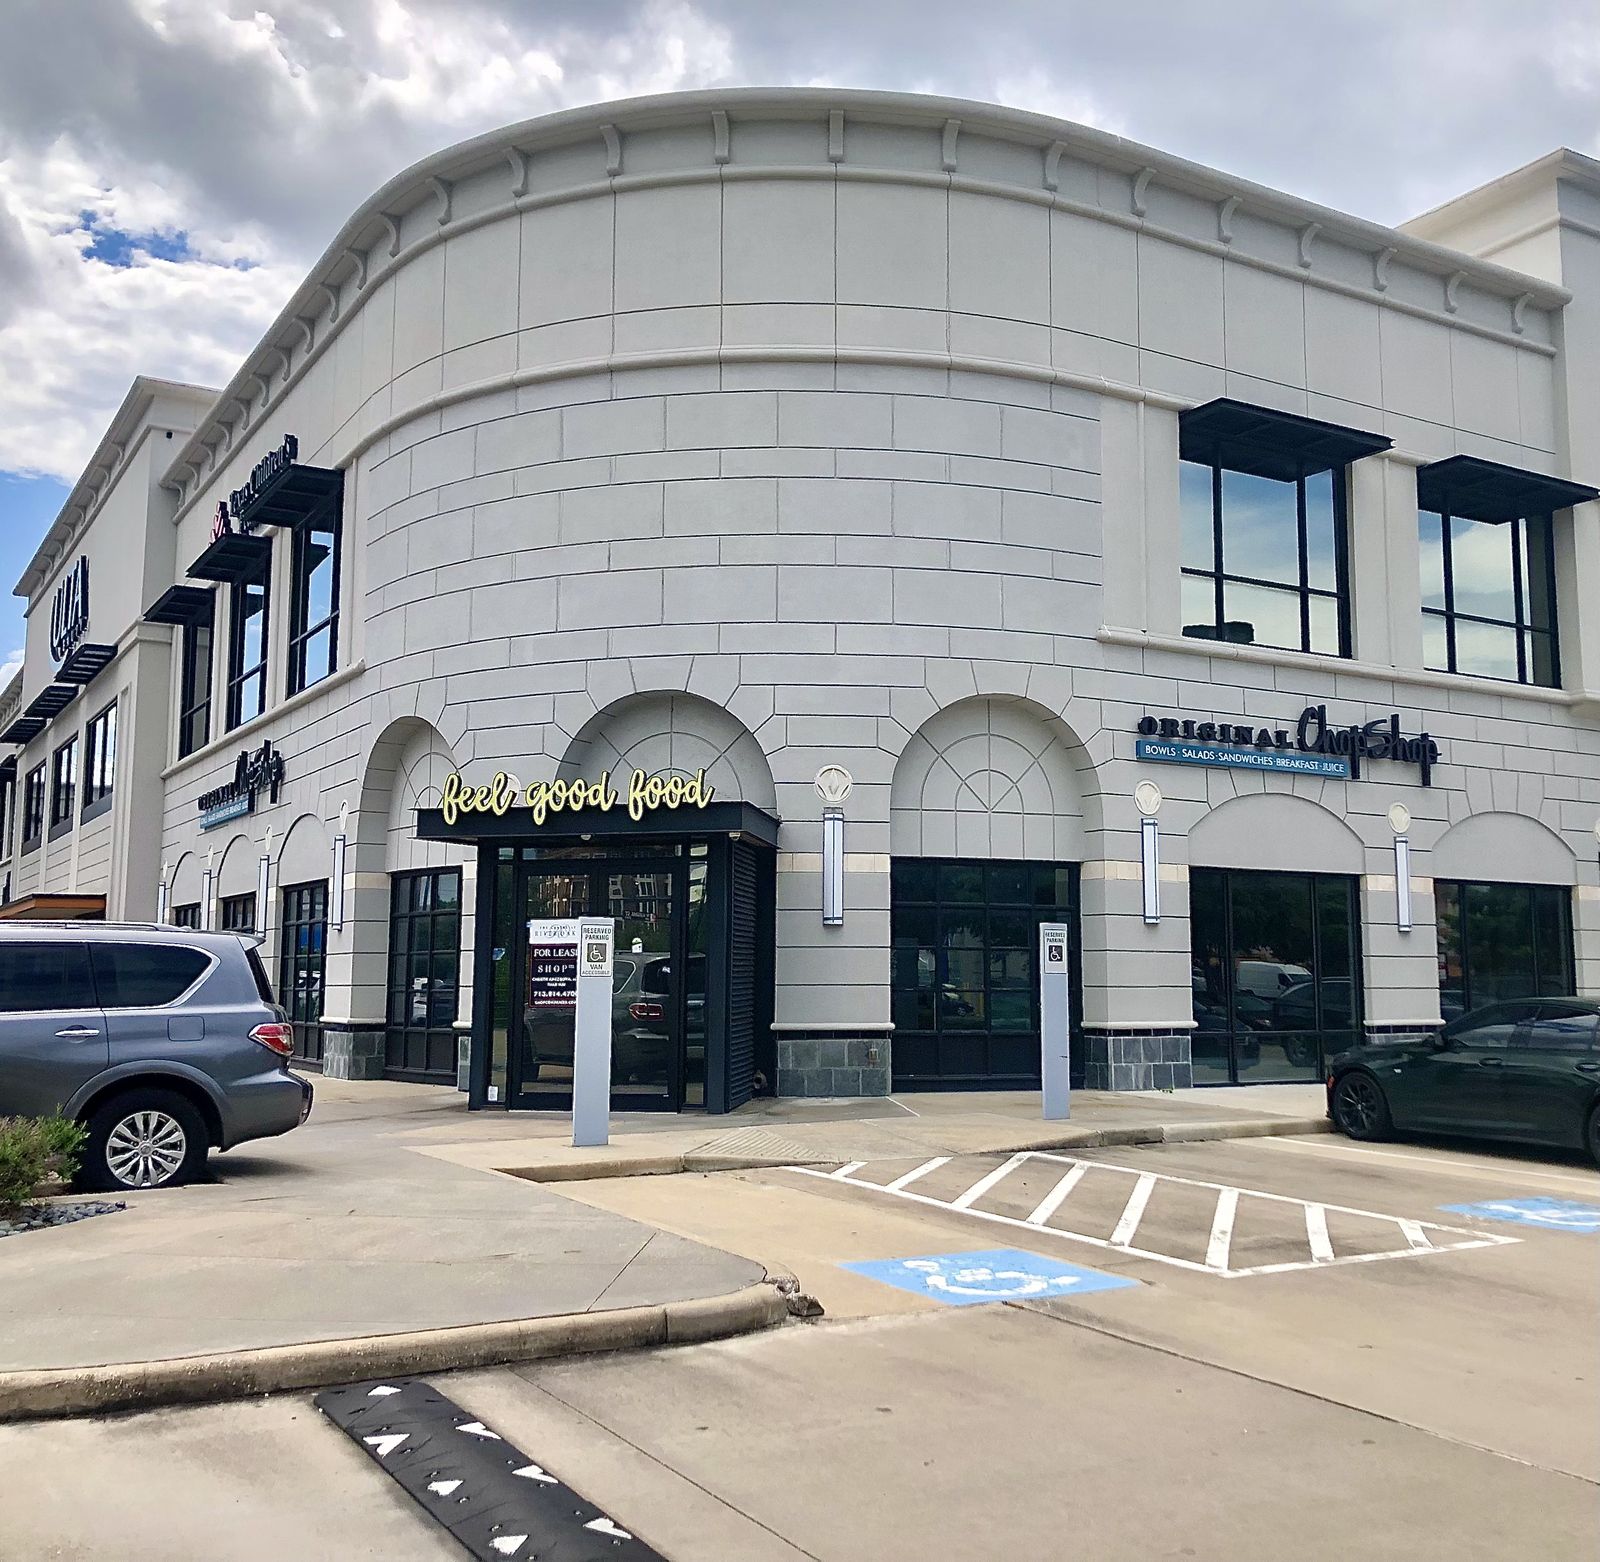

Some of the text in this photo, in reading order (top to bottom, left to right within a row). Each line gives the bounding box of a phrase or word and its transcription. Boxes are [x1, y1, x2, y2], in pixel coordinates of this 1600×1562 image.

[1138, 715, 1299, 749] ORIGINAL
[1145, 745, 1345, 773] BOWLS SALADS SANDWICHES BREAKFAST JUICE
[442, 768, 715, 826] feel good food
[533, 948, 551, 958] FOR
